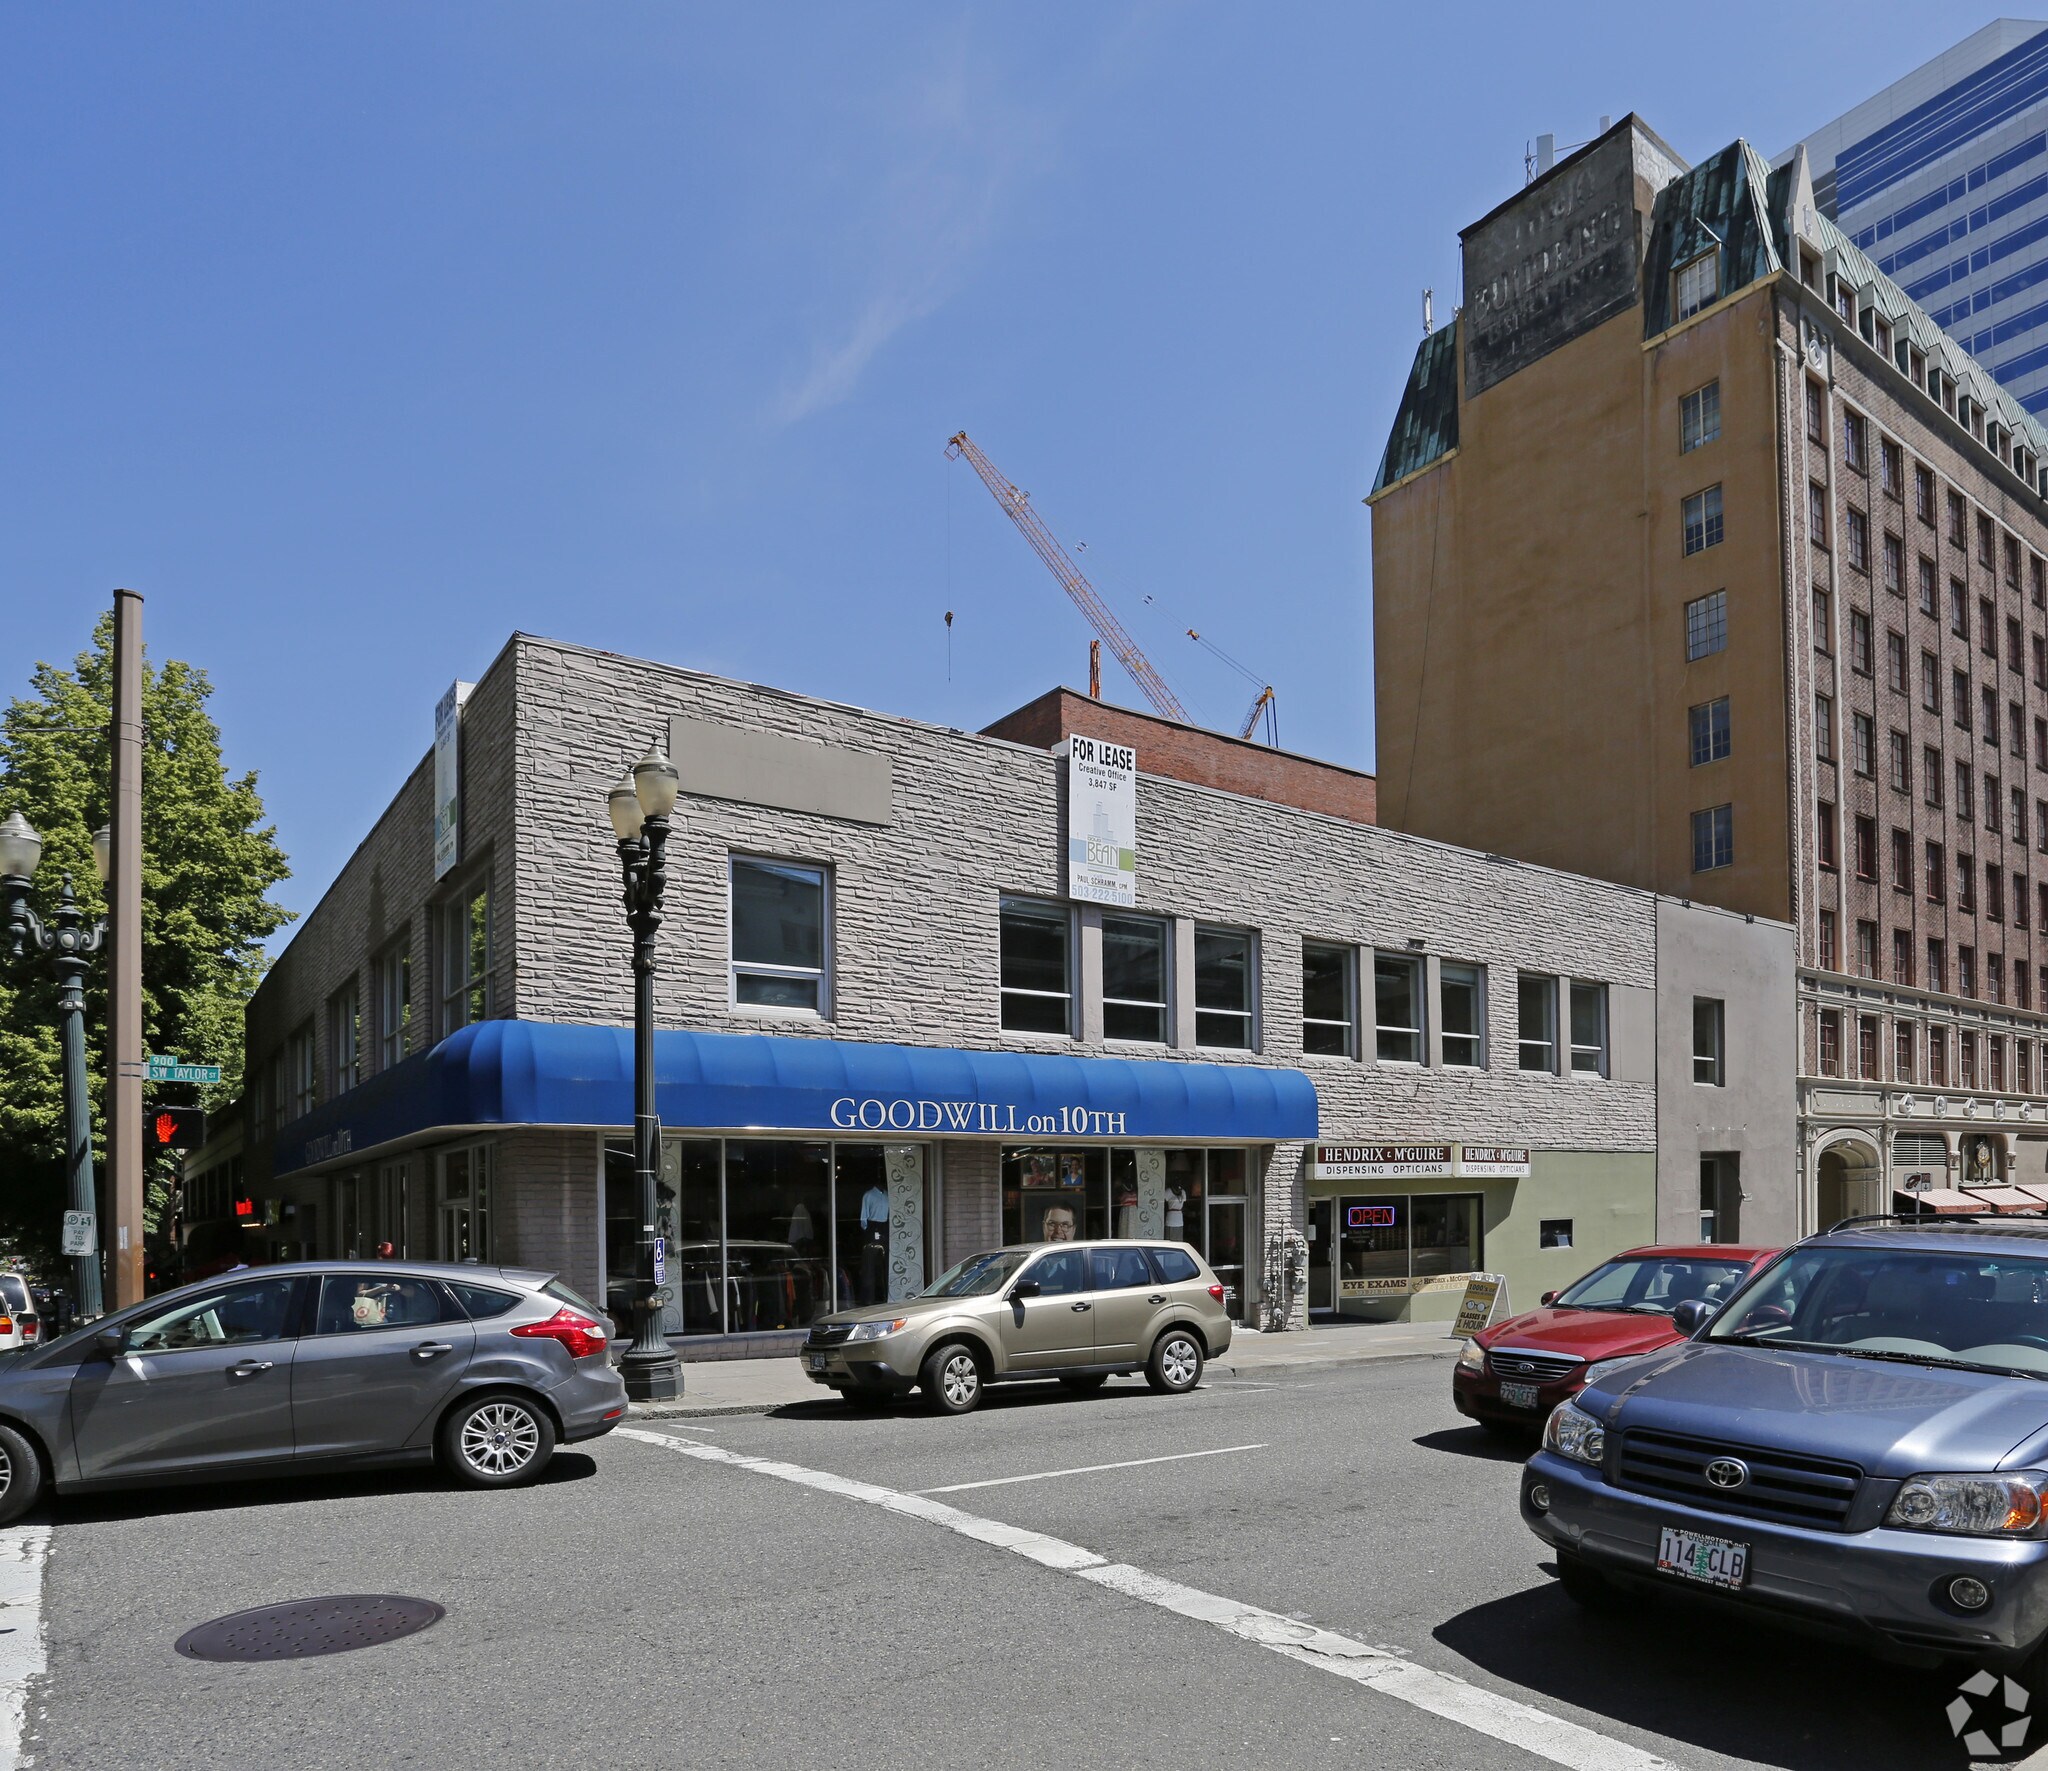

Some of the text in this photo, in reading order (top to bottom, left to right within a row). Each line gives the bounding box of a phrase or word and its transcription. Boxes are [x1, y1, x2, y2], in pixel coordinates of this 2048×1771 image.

[1073, 738, 1132, 771] FOR LEASE
[1079, 763, 1127, 781] Creative Office
[1089, 778, 1117, 791] 3,847 SF
[1087, 841, 1118, 866] BEAN
[1077, 874, 1089, 884] PAUL
[153, 1056, 174, 1066] 900
[152, 1066, 167, 1078] SW
[174, 1067, 208, 1080] TAYLOR
[830, 1098, 1126, 1134] GOODWILL on 10TH
[1325, 1147, 1384, 1162] HENDRIX
[1465, 1148, 1496, 1162] HENDRIX
[1326, 1164, 1443, 1175] DISPENSING OPTICIANS
[1466, 1165, 1525, 1173] DISPENSING OPTICIANS
[1351, 1209, 1392, 1224] OPEN
[1343, 1279, 1407, 1290] EYE EXAMS
[1460, 1312, 1481, 1320] GLASSES
[1457, 1319, 1485, 1330] 1 HOUR
[1519, 1363, 1531, 1371] KIA
[1665, 1538, 1743, 1578] 114 CLB
[1676, 1570, 1685, 1578] THE
[1715, 1580, 1728, 1589] SINCE
